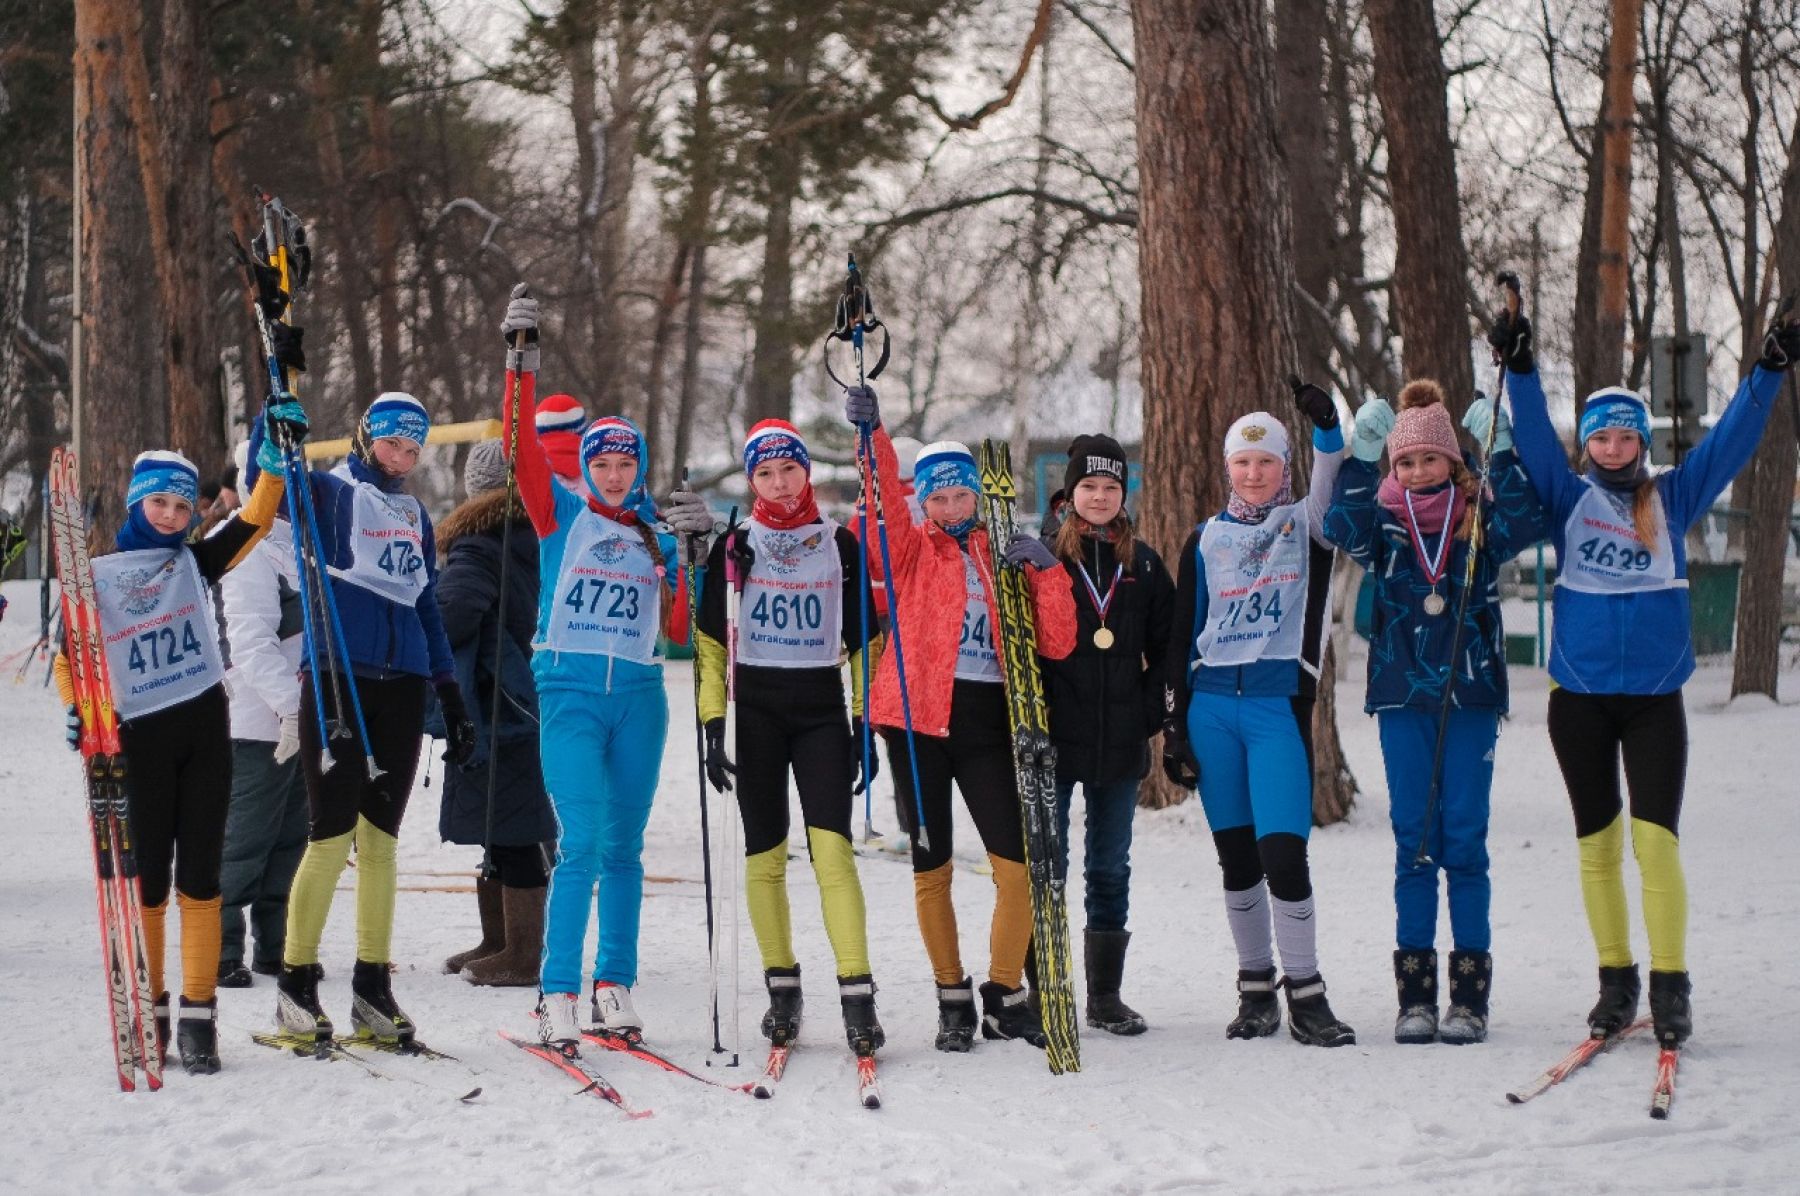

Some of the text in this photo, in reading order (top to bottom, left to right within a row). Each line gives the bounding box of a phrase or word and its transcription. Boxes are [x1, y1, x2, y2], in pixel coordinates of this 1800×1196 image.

[1086, 455, 1122, 480] EVERLAST
[565, 578, 639, 621] 4723
[751, 592, 821, 630] 4610
[128, 619, 202, 674] 4724
[111, 970, 135, 1084] ATOMIC
[135, 968, 161, 1082] ATOMIC
